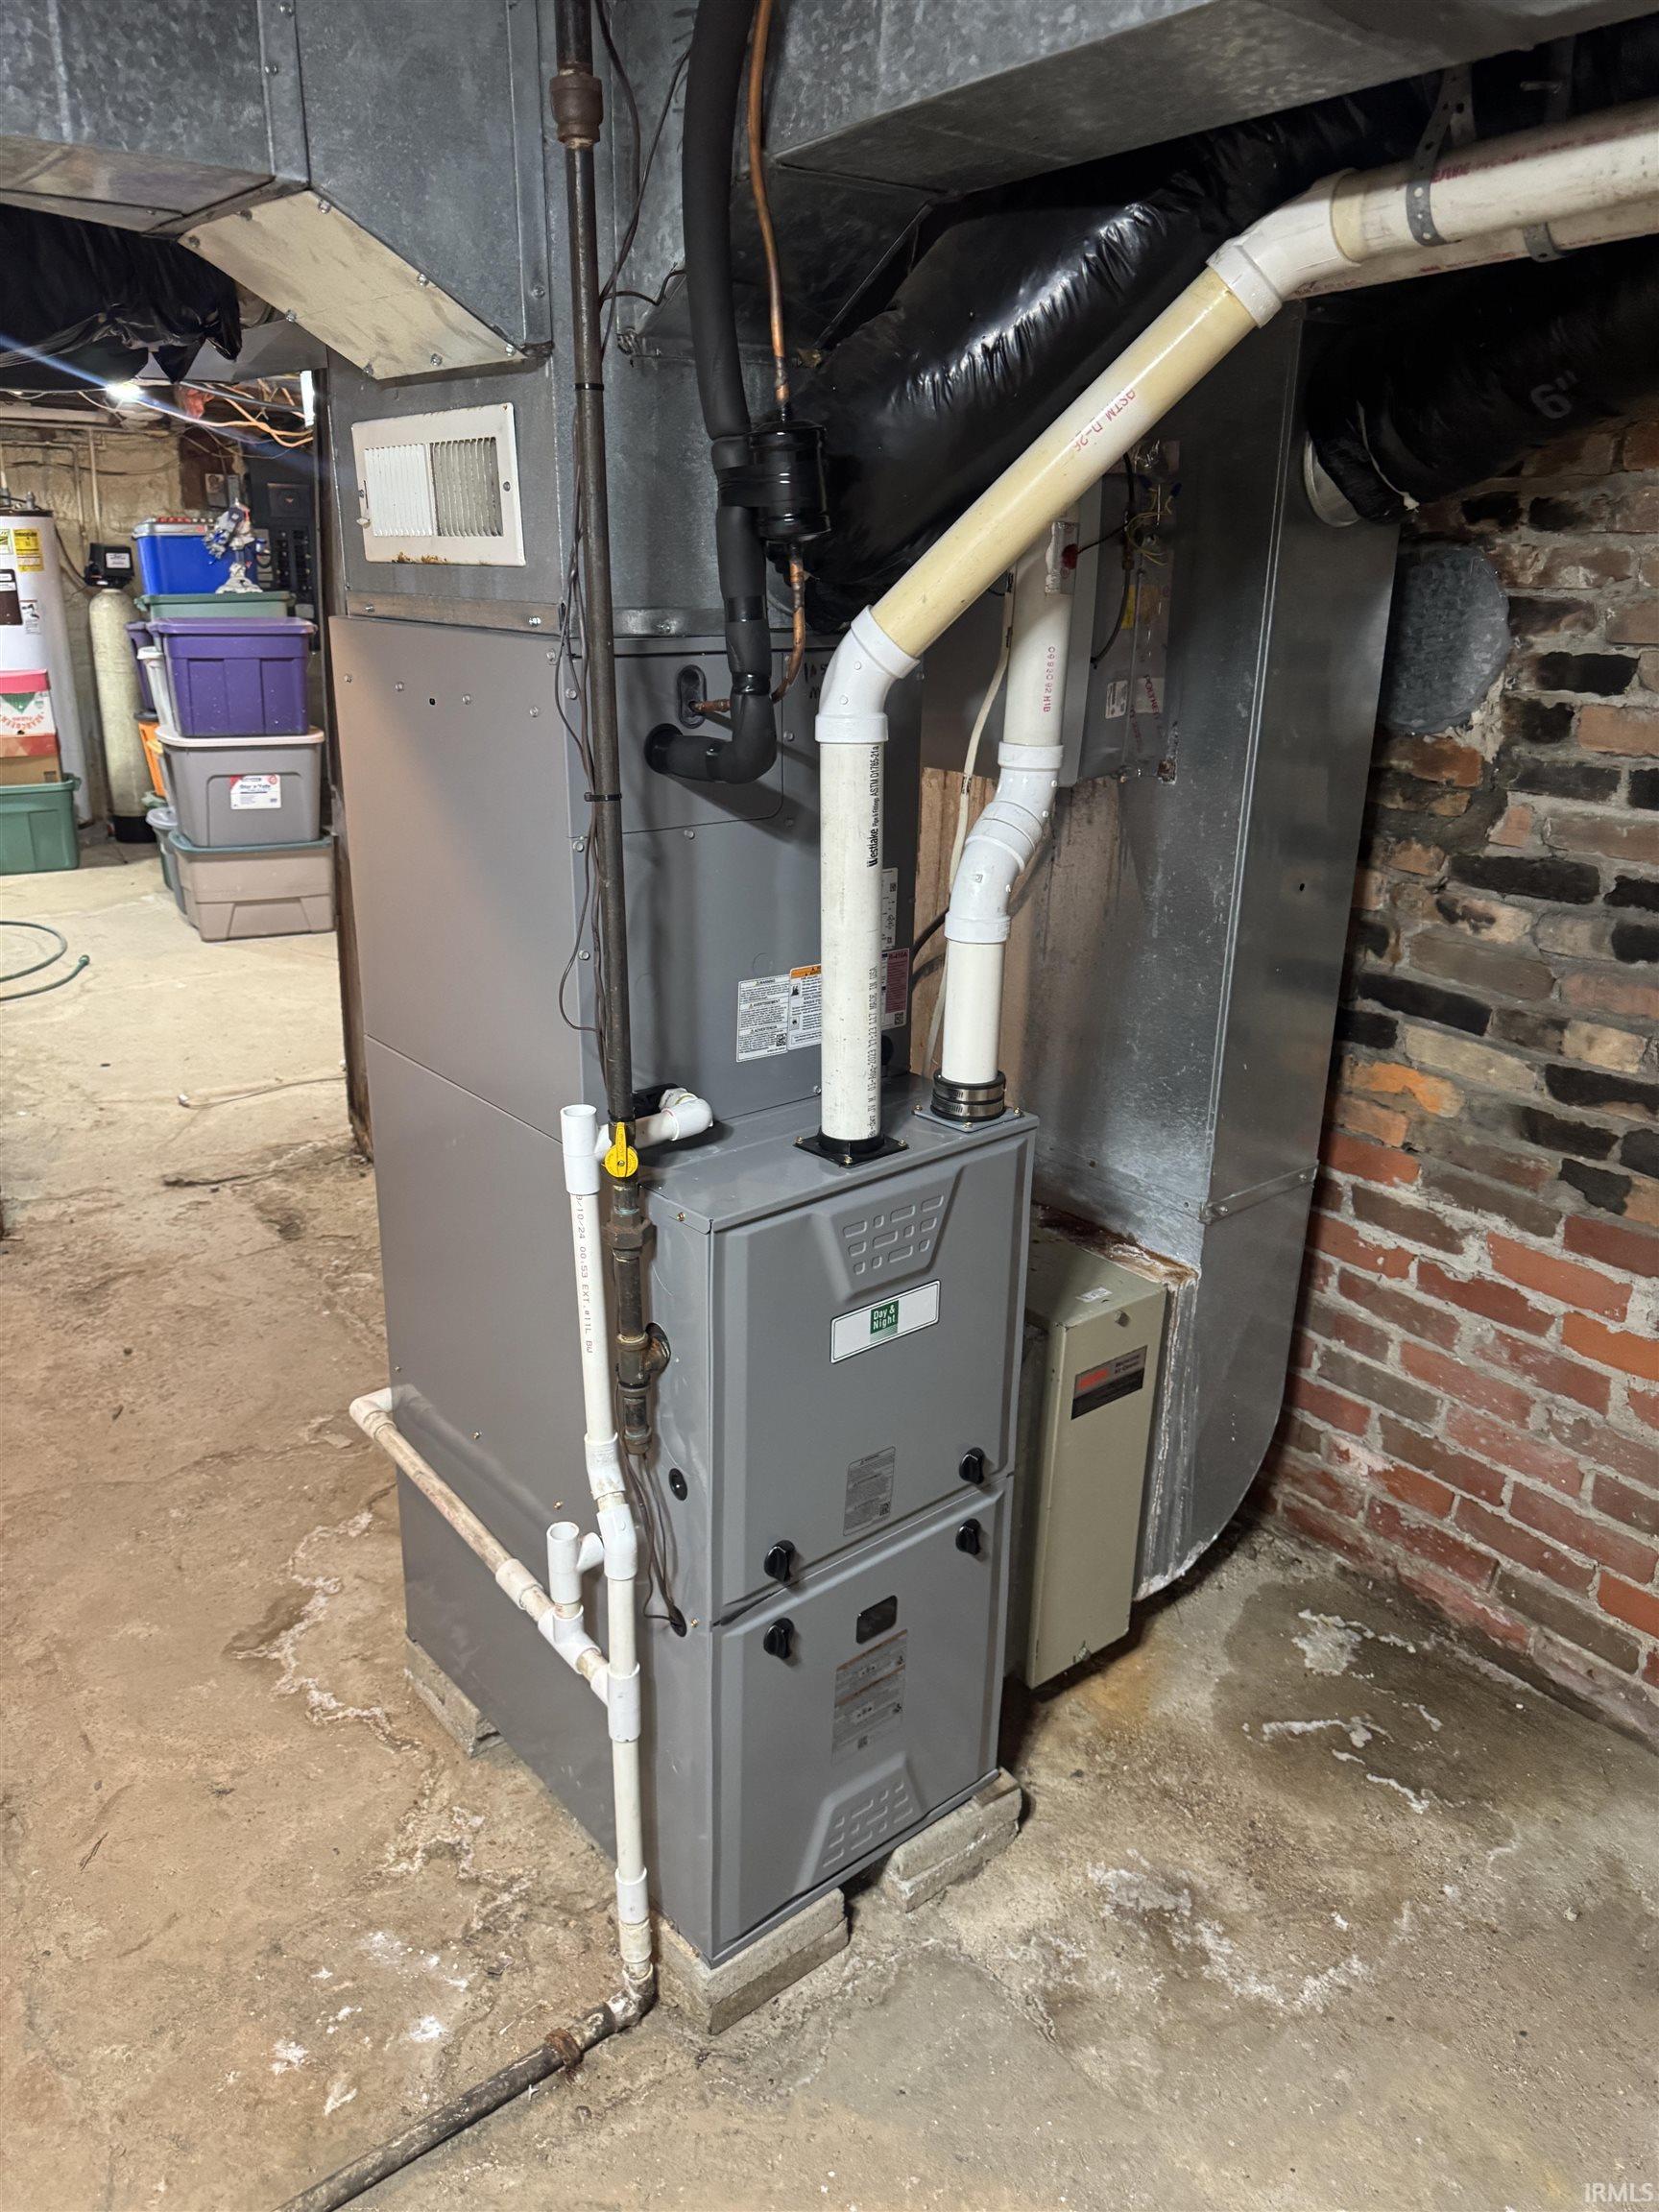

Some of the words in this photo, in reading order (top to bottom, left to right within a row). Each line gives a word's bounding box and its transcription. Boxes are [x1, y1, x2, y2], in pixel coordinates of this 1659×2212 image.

[869, 745, 879, 778] D1785-21a
[870, 779, 879, 796] ASTM
[867, 828, 878, 868] Westlake
[869, 966, 878, 980] USA
[869, 981, 878, 990] IN
[868, 993, 878, 1010] MADE
[873, 1309, 887, 1320] Day
[889, 1305, 896, 1314] &
[873, 1314, 896, 1330] Night
